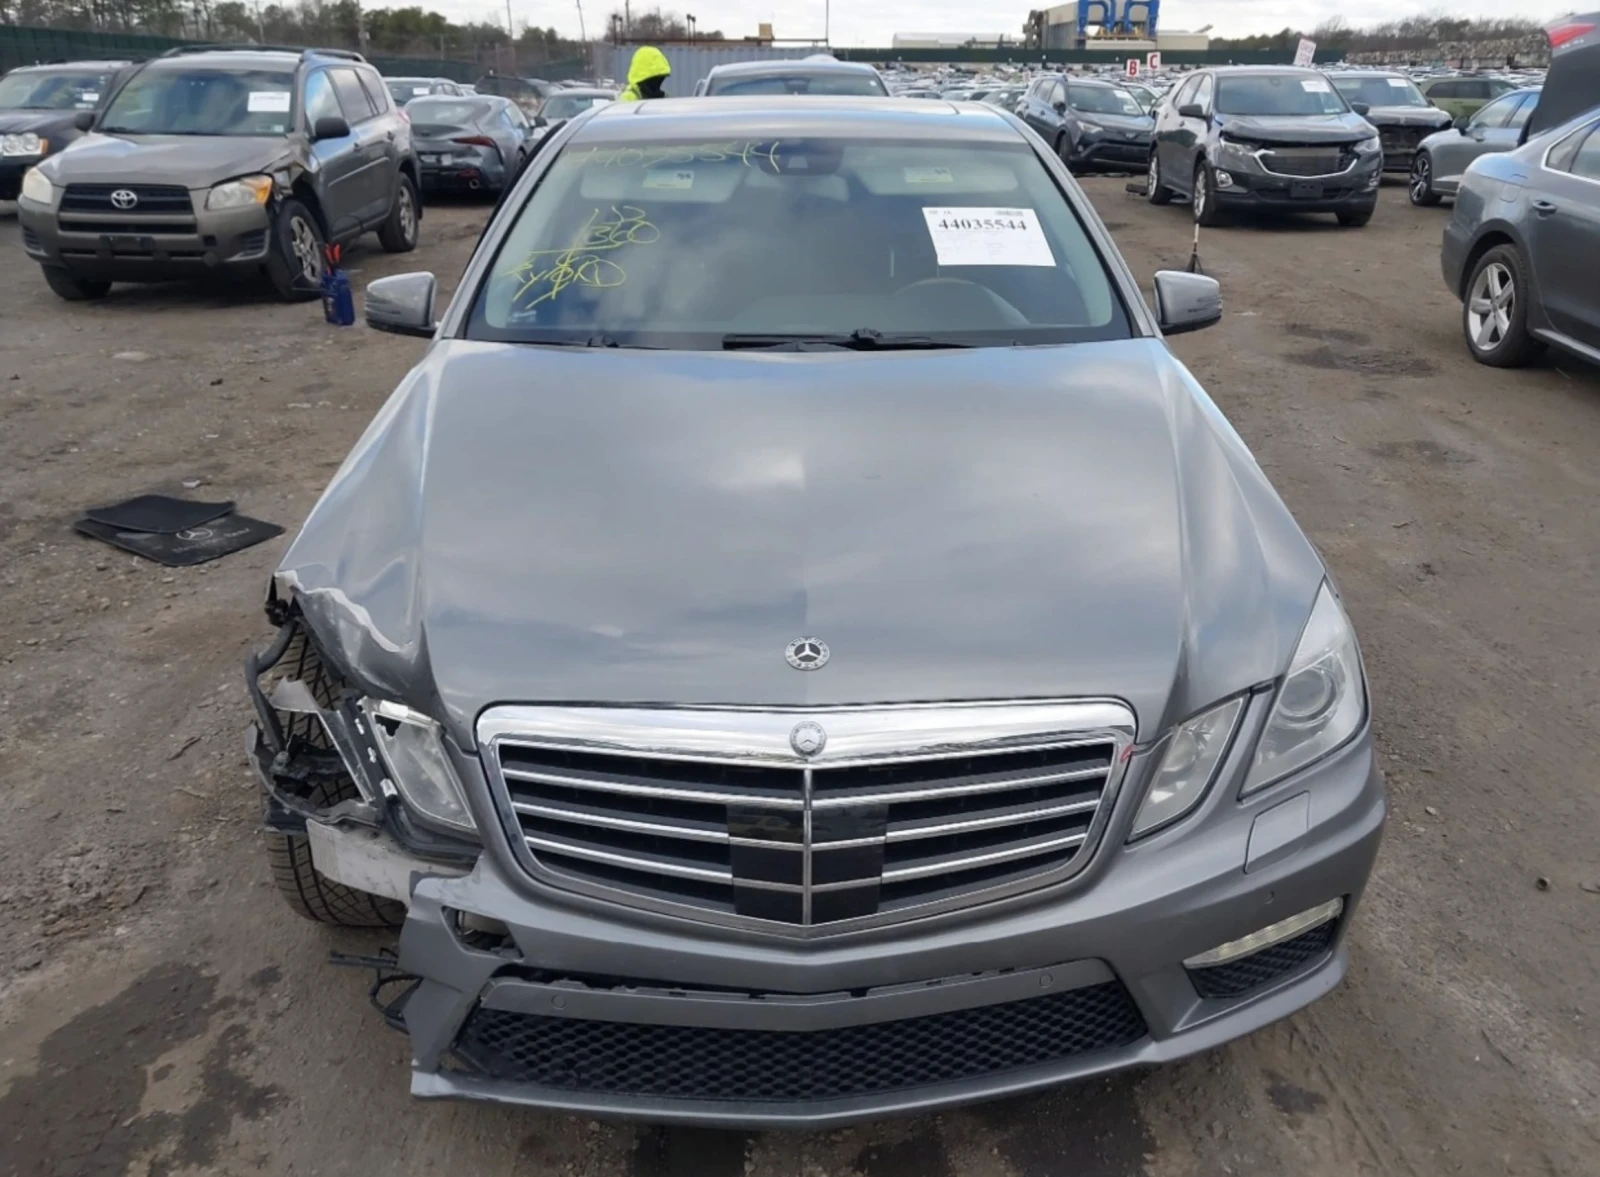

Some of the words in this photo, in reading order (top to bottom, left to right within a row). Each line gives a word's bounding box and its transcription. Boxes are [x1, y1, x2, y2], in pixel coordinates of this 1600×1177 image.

[1129, 60, 1137, 76] B
[1150, 54, 1158, 69] C
[938, 218, 1027, 231] 44035544
